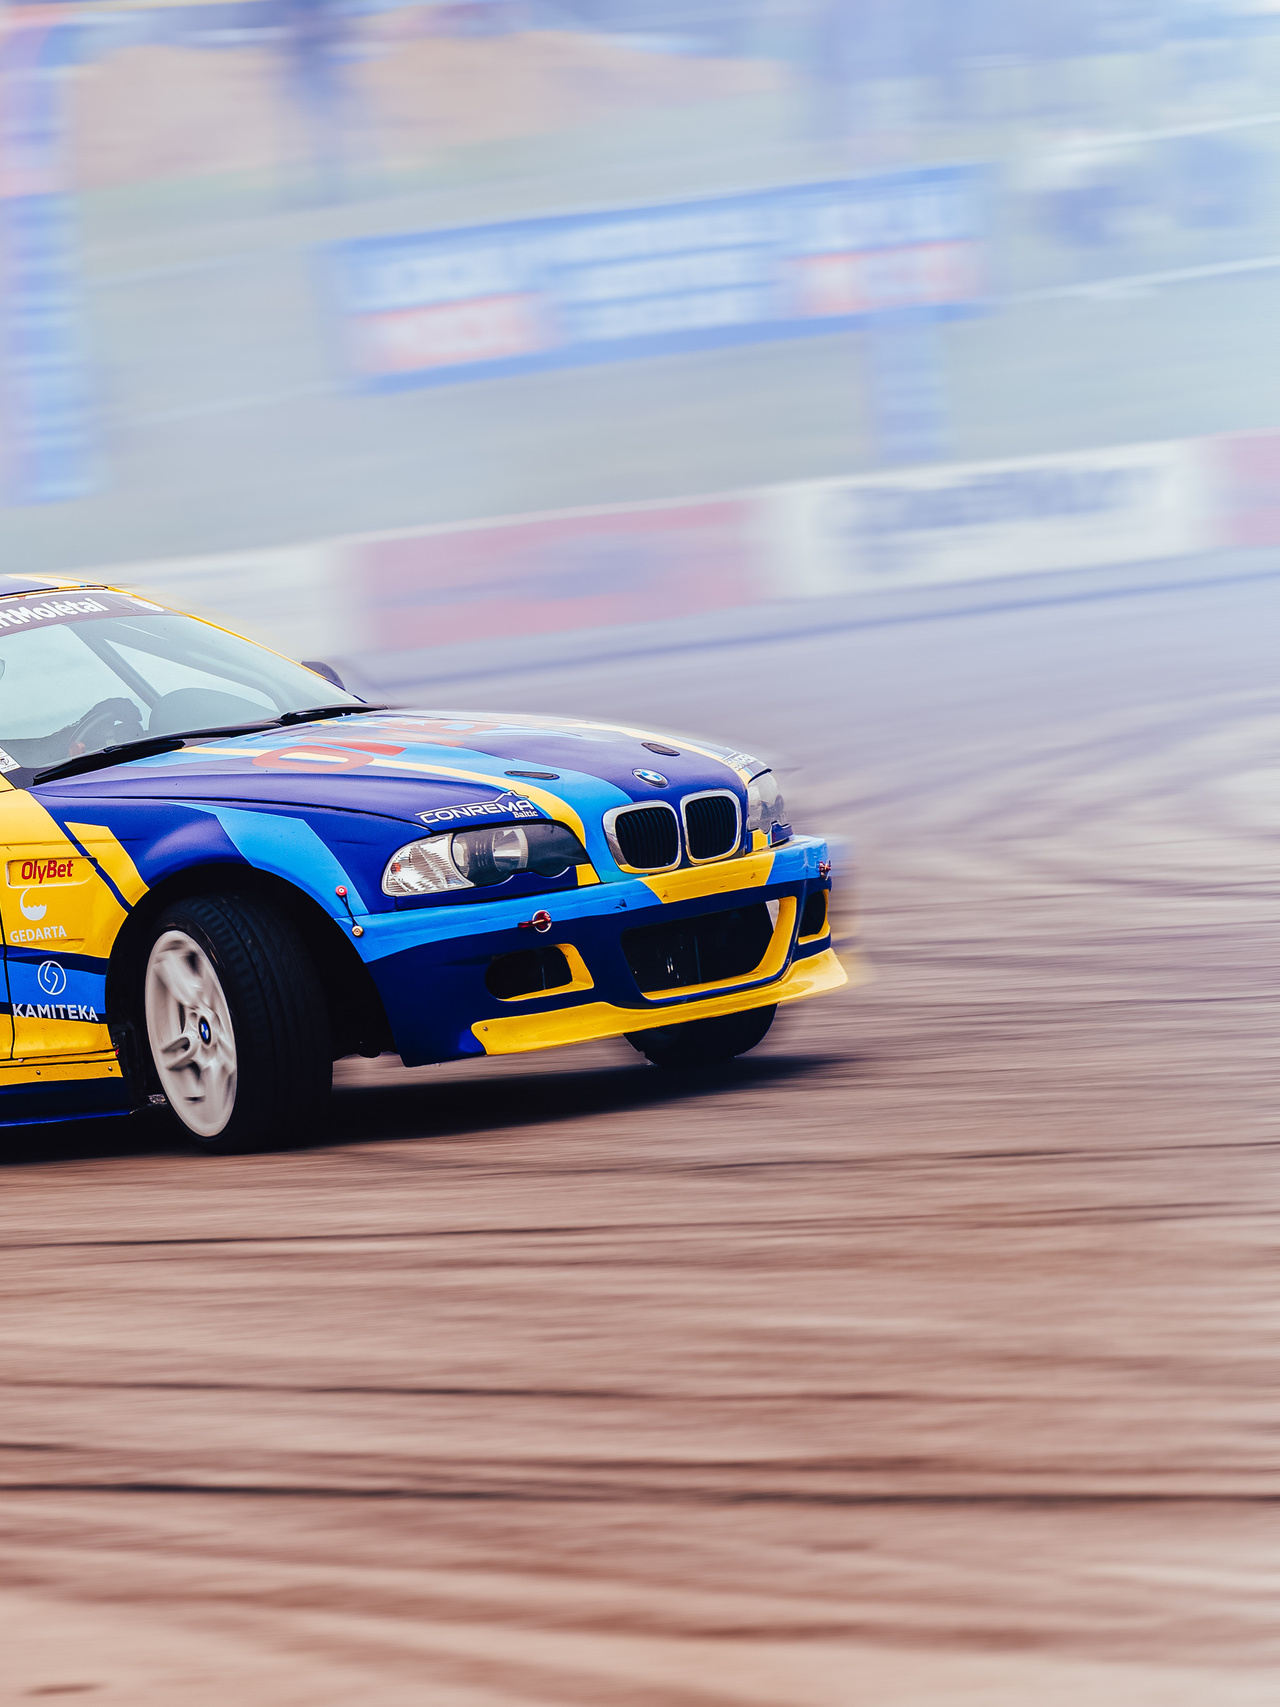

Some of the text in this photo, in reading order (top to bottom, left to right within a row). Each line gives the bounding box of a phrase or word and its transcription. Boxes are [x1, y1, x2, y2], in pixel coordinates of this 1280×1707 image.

[420, 799, 535, 824] CONREMA
[512, 810, 539, 819] Baltic
[21, 859, 74, 885] OlyBet
[9, 925, 68, 943] GEDARTA
[11, 1003, 100, 1022] KAMITEKA
